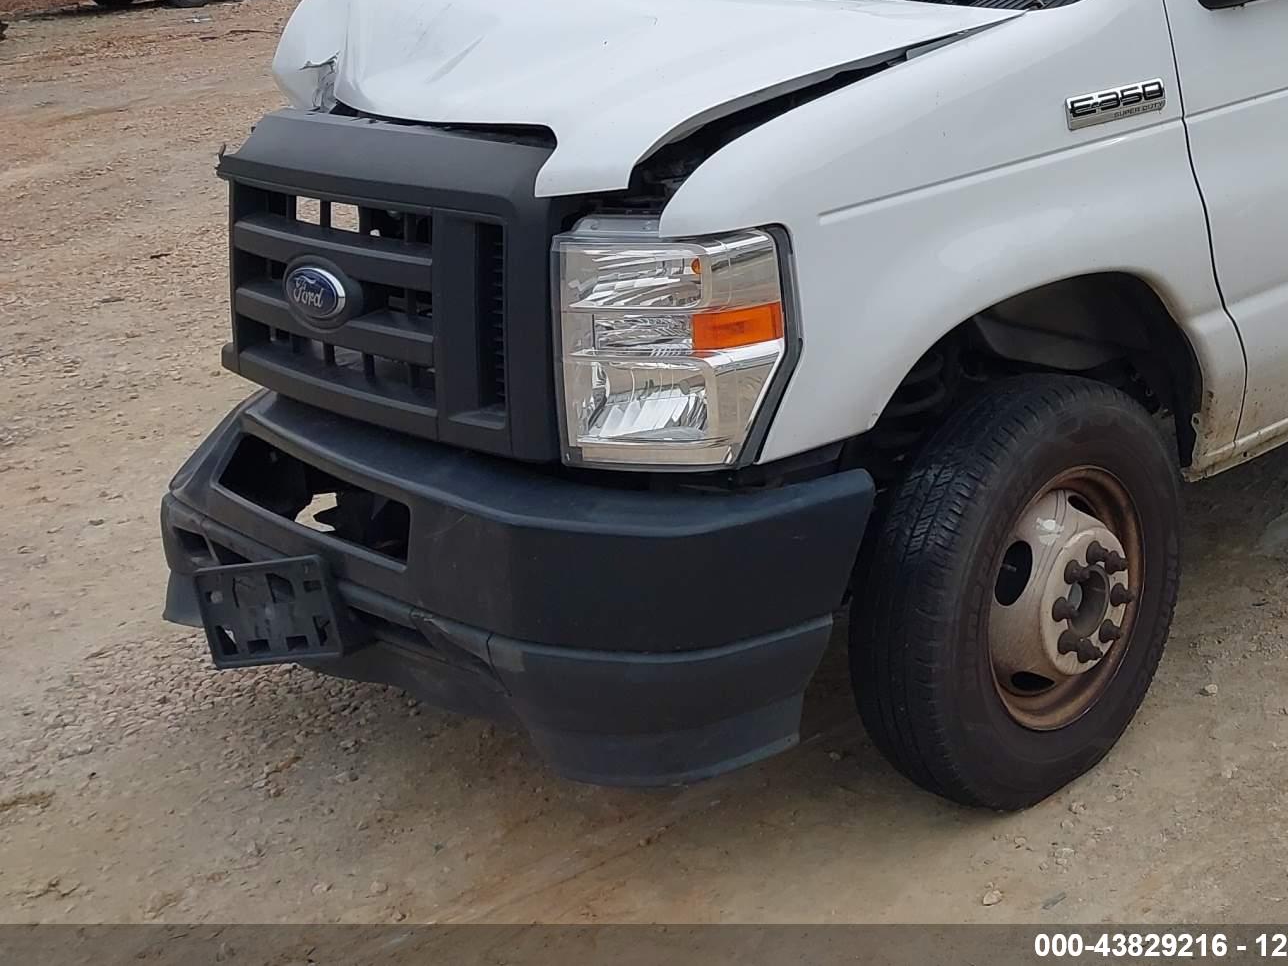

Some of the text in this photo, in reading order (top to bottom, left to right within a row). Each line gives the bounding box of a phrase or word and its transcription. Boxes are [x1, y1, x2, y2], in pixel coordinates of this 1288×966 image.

[1069, 81, 1165, 118] E-350
[1113, 100, 1164, 119] SUPER DUTY
[292, 274, 325, 309] Ford
